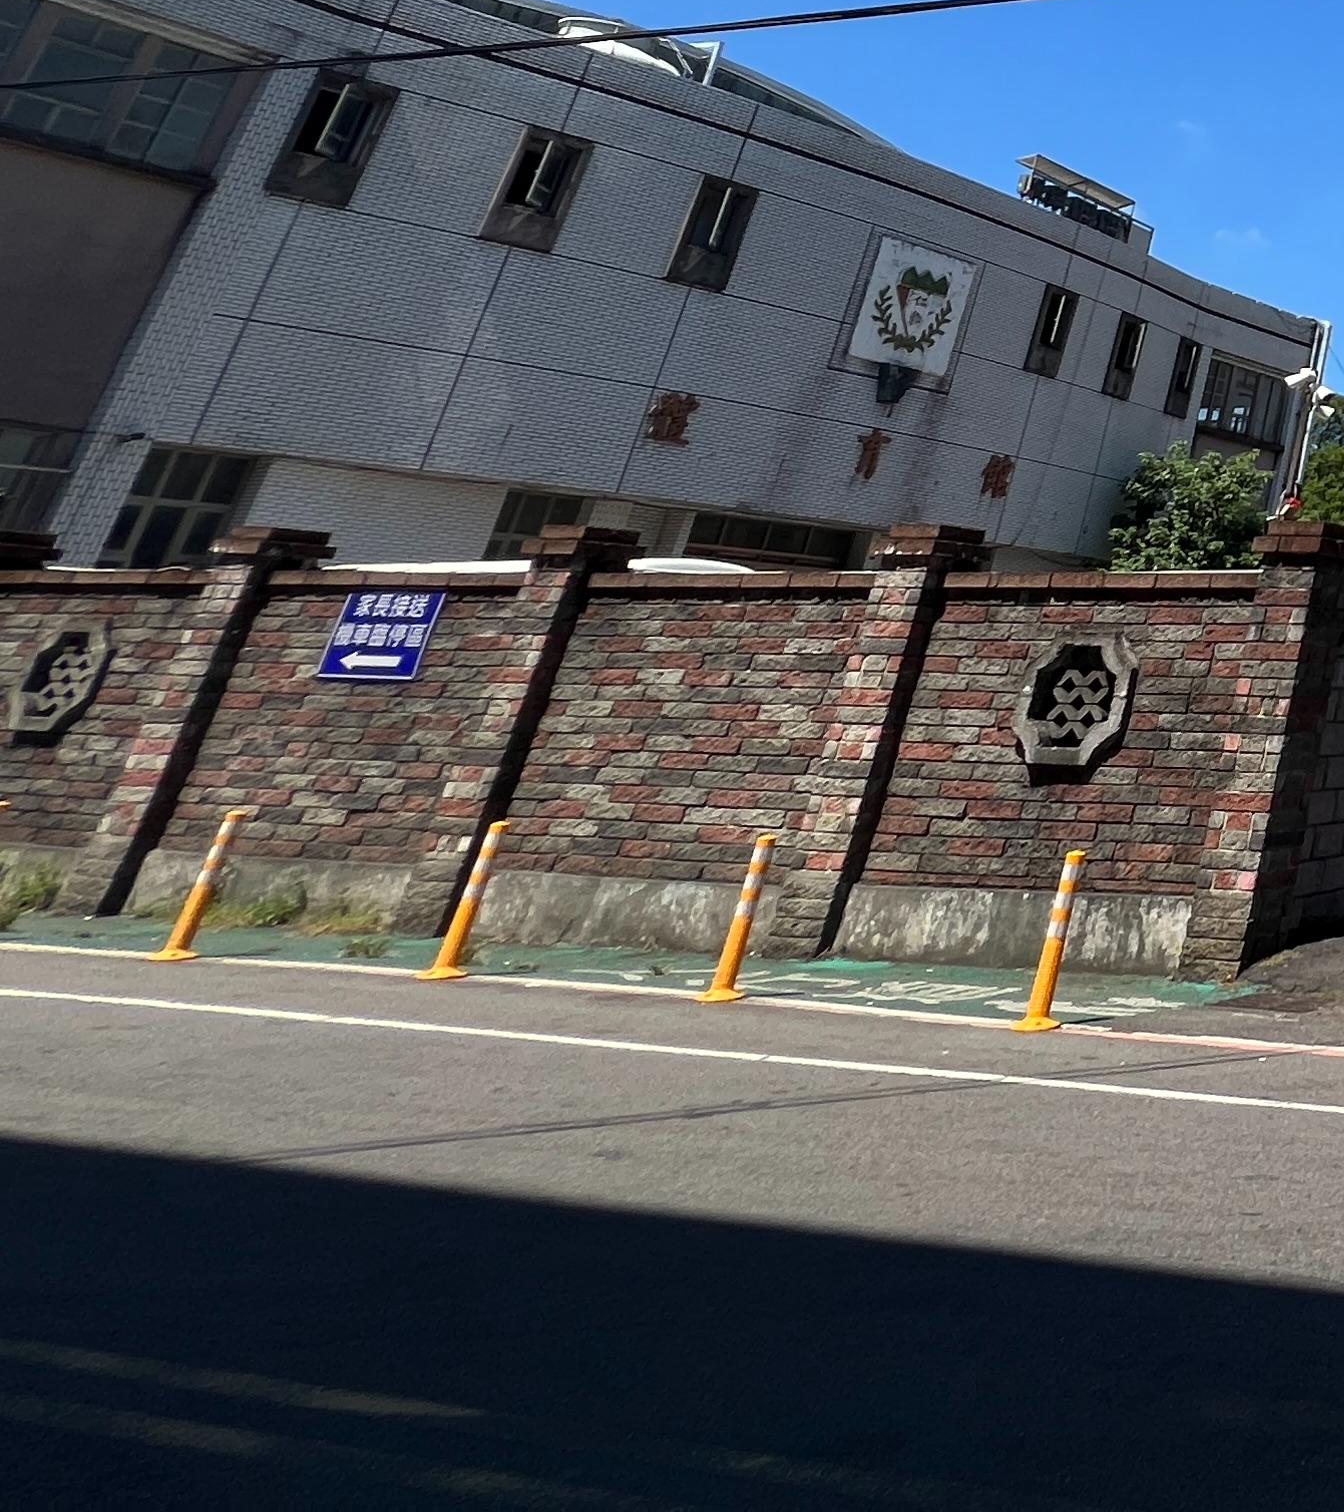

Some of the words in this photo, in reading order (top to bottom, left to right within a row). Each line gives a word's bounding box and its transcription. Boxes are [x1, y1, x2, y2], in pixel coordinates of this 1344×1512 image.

[647, 392, 1016, 498] 體育館
[352, 592, 431, 619] 家長接送
[333, 622, 429, 648] 機車暫停區
